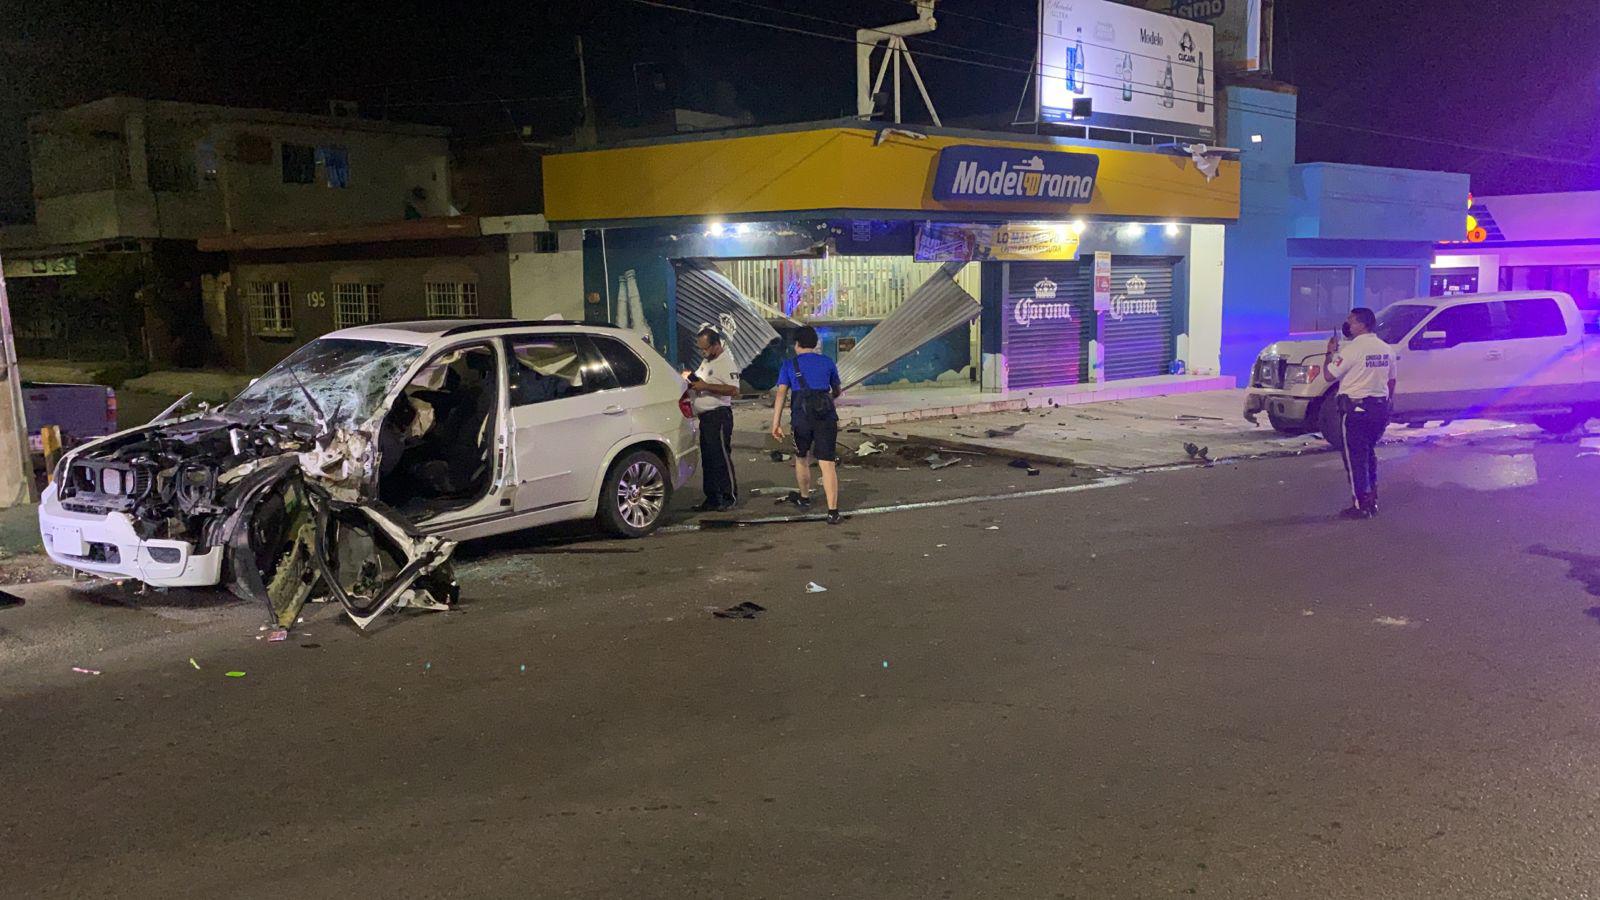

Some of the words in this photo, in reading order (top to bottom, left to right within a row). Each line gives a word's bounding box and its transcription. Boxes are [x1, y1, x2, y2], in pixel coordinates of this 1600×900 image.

[1140, 27, 1164, 47] Modelo
[952, 161, 1093, 198] Modelorama
[307, 291, 326, 308] 195
[1014, 297, 1073, 327] Corona
[1110, 294, 1160, 322] Corona
